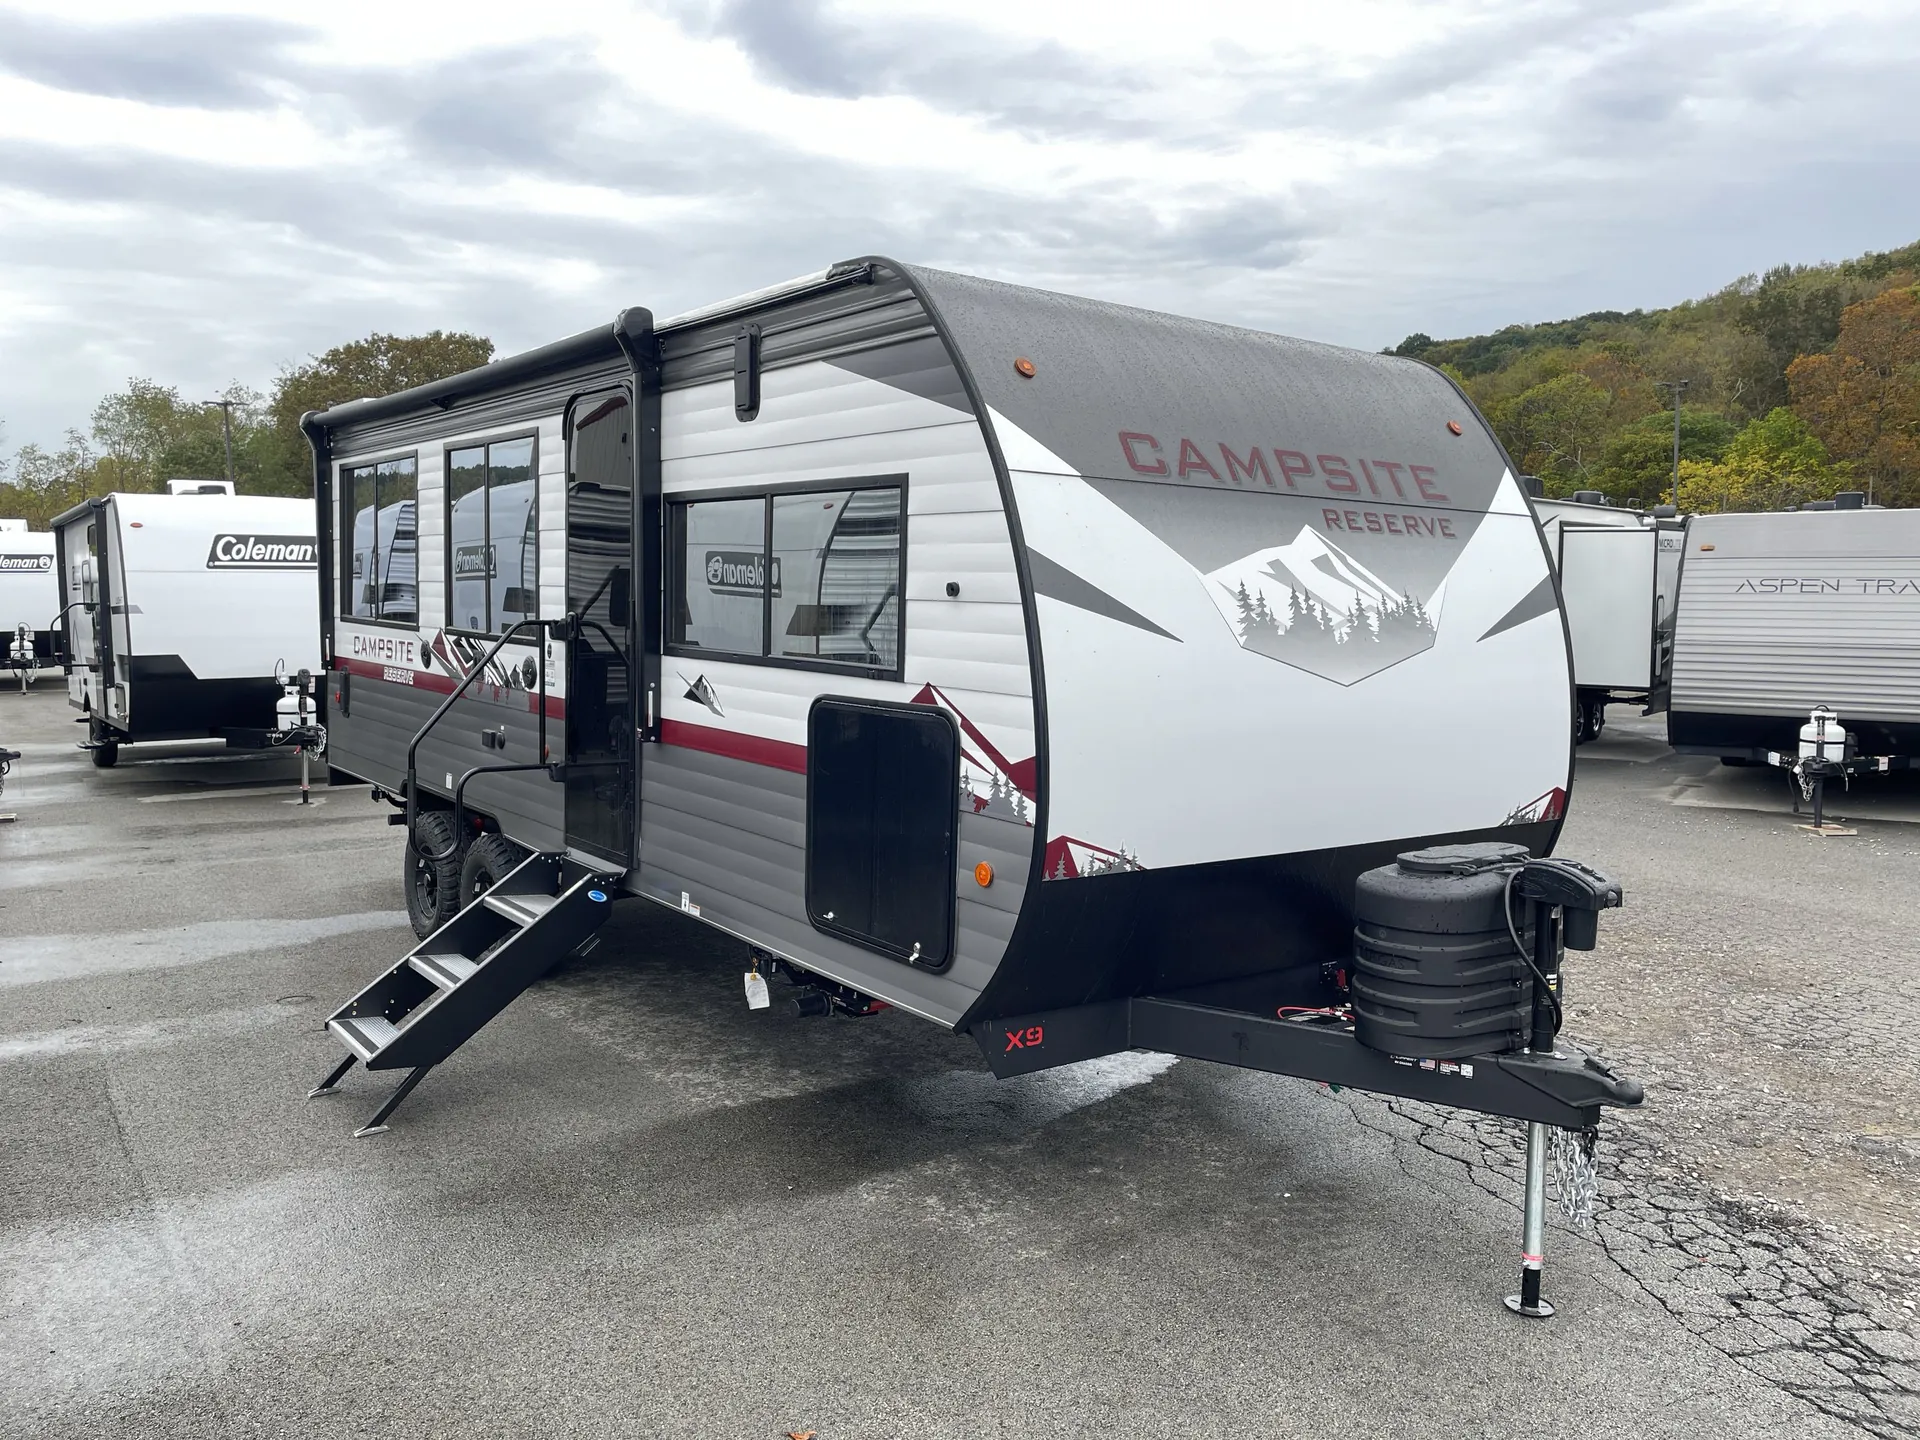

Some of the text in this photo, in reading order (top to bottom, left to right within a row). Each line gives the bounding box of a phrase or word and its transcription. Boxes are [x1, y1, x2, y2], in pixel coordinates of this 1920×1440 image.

[1118, 430, 1450, 502] CAMPSITE
[1321, 507, 1456, 538] RESERVE
[216, 536, 313, 561] Coleman
[1736, 578, 1920, 594] ASPEN TRA
[353, 635, 414, 663] CAMPSITE
[383, 666, 415, 686] RESERVE
[1005, 1026, 1043, 1052] X9
